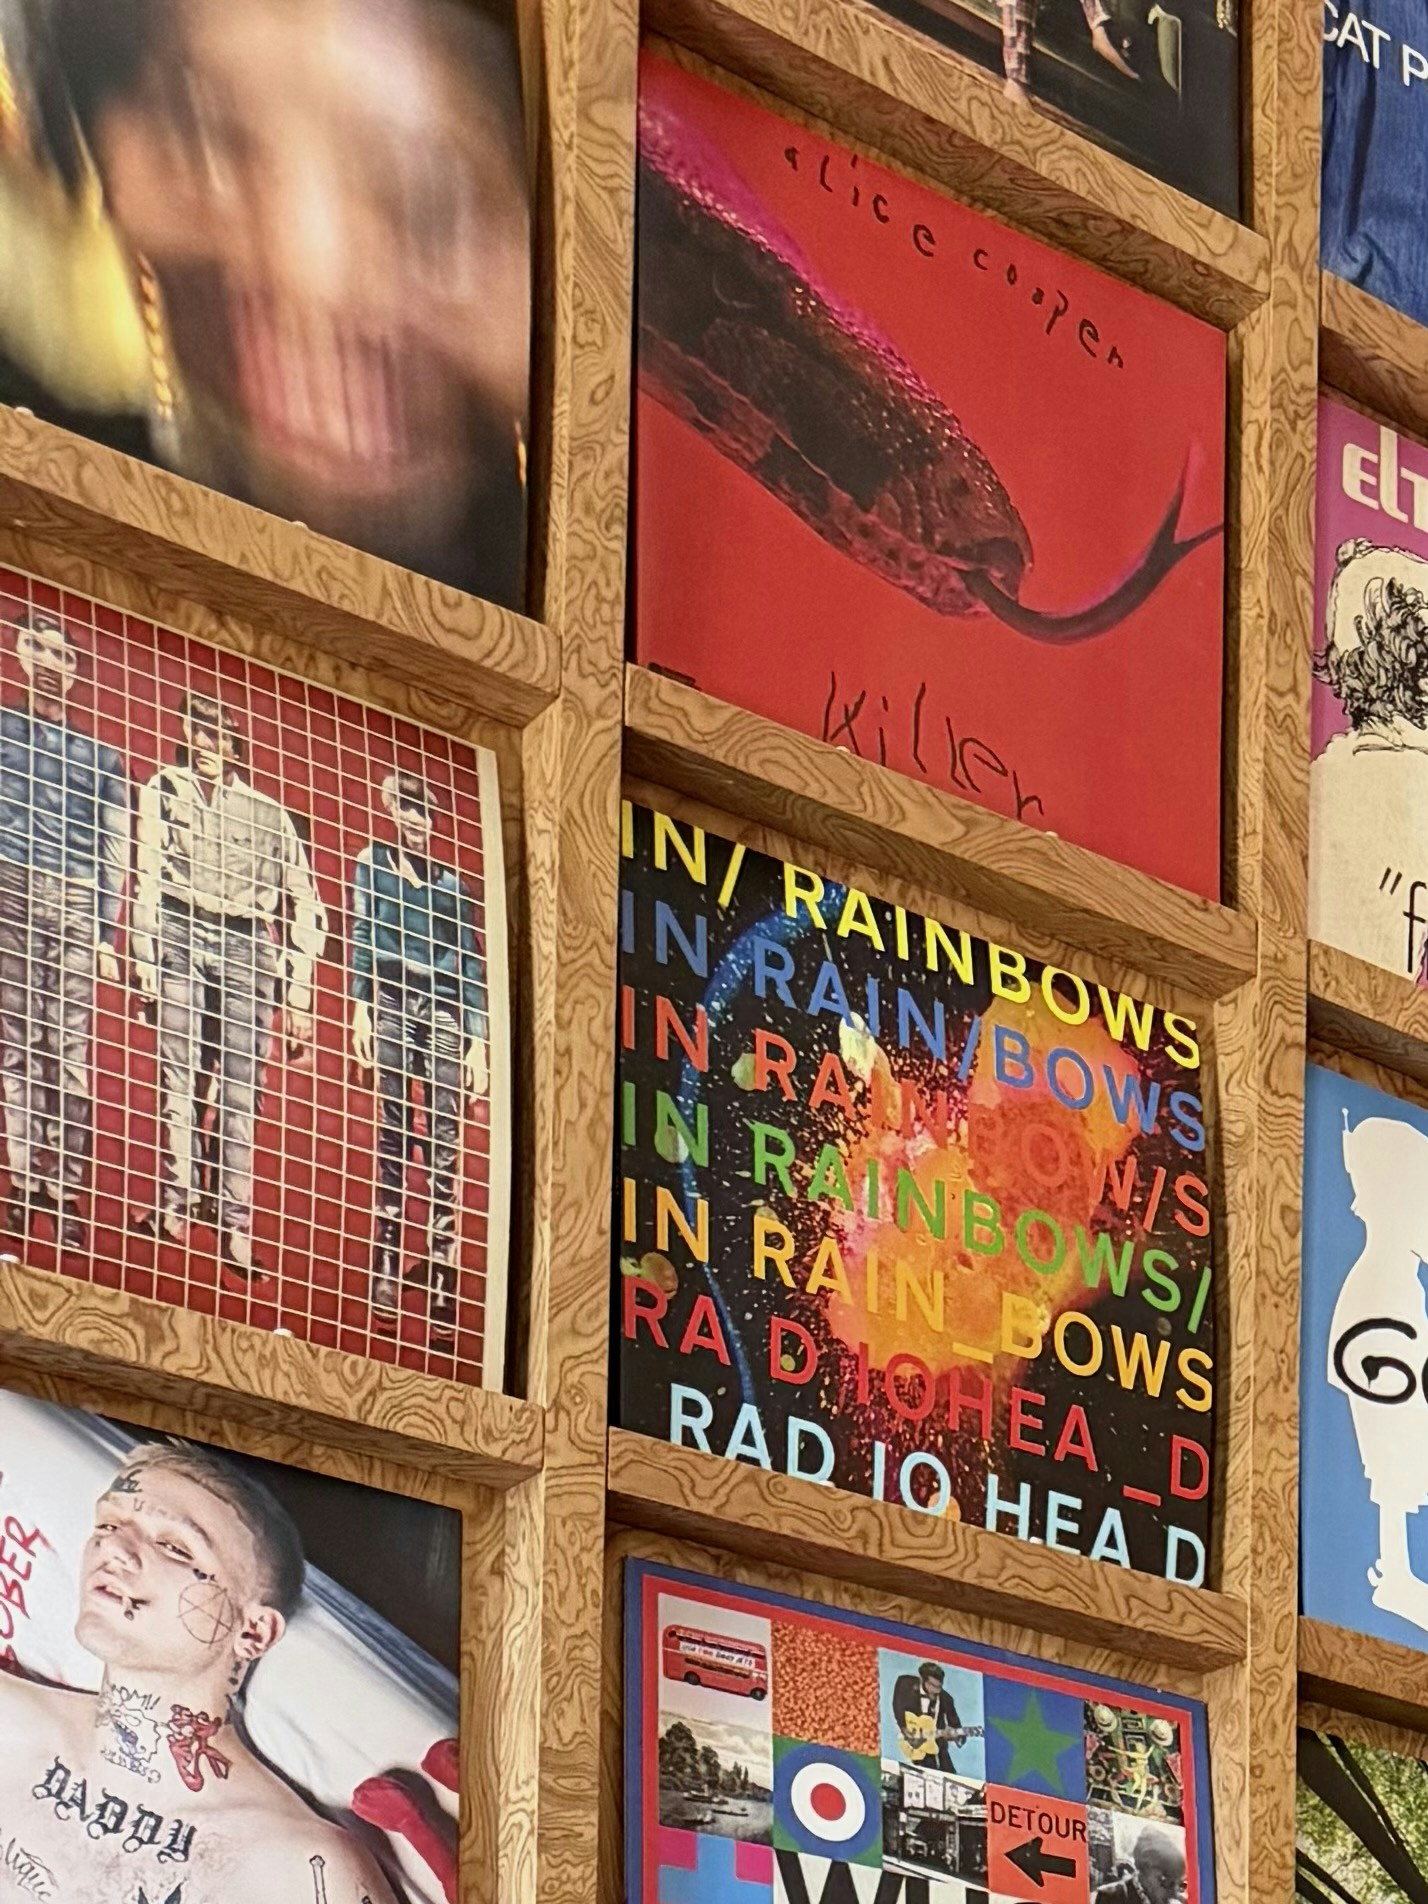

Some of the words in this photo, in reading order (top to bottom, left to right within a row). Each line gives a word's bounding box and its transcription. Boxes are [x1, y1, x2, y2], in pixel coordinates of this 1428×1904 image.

[784, 146, 937, 257] alice
[622, 890, 707, 978] IN
[782, 863, 1201, 1070] RAINBOWS
[622, 986, 708, 1074] IN
[622, 1081, 708, 1168] IN
[622, 1177, 709, 1262] IN
[990, 1800, 1087, 1843] DETOUR
